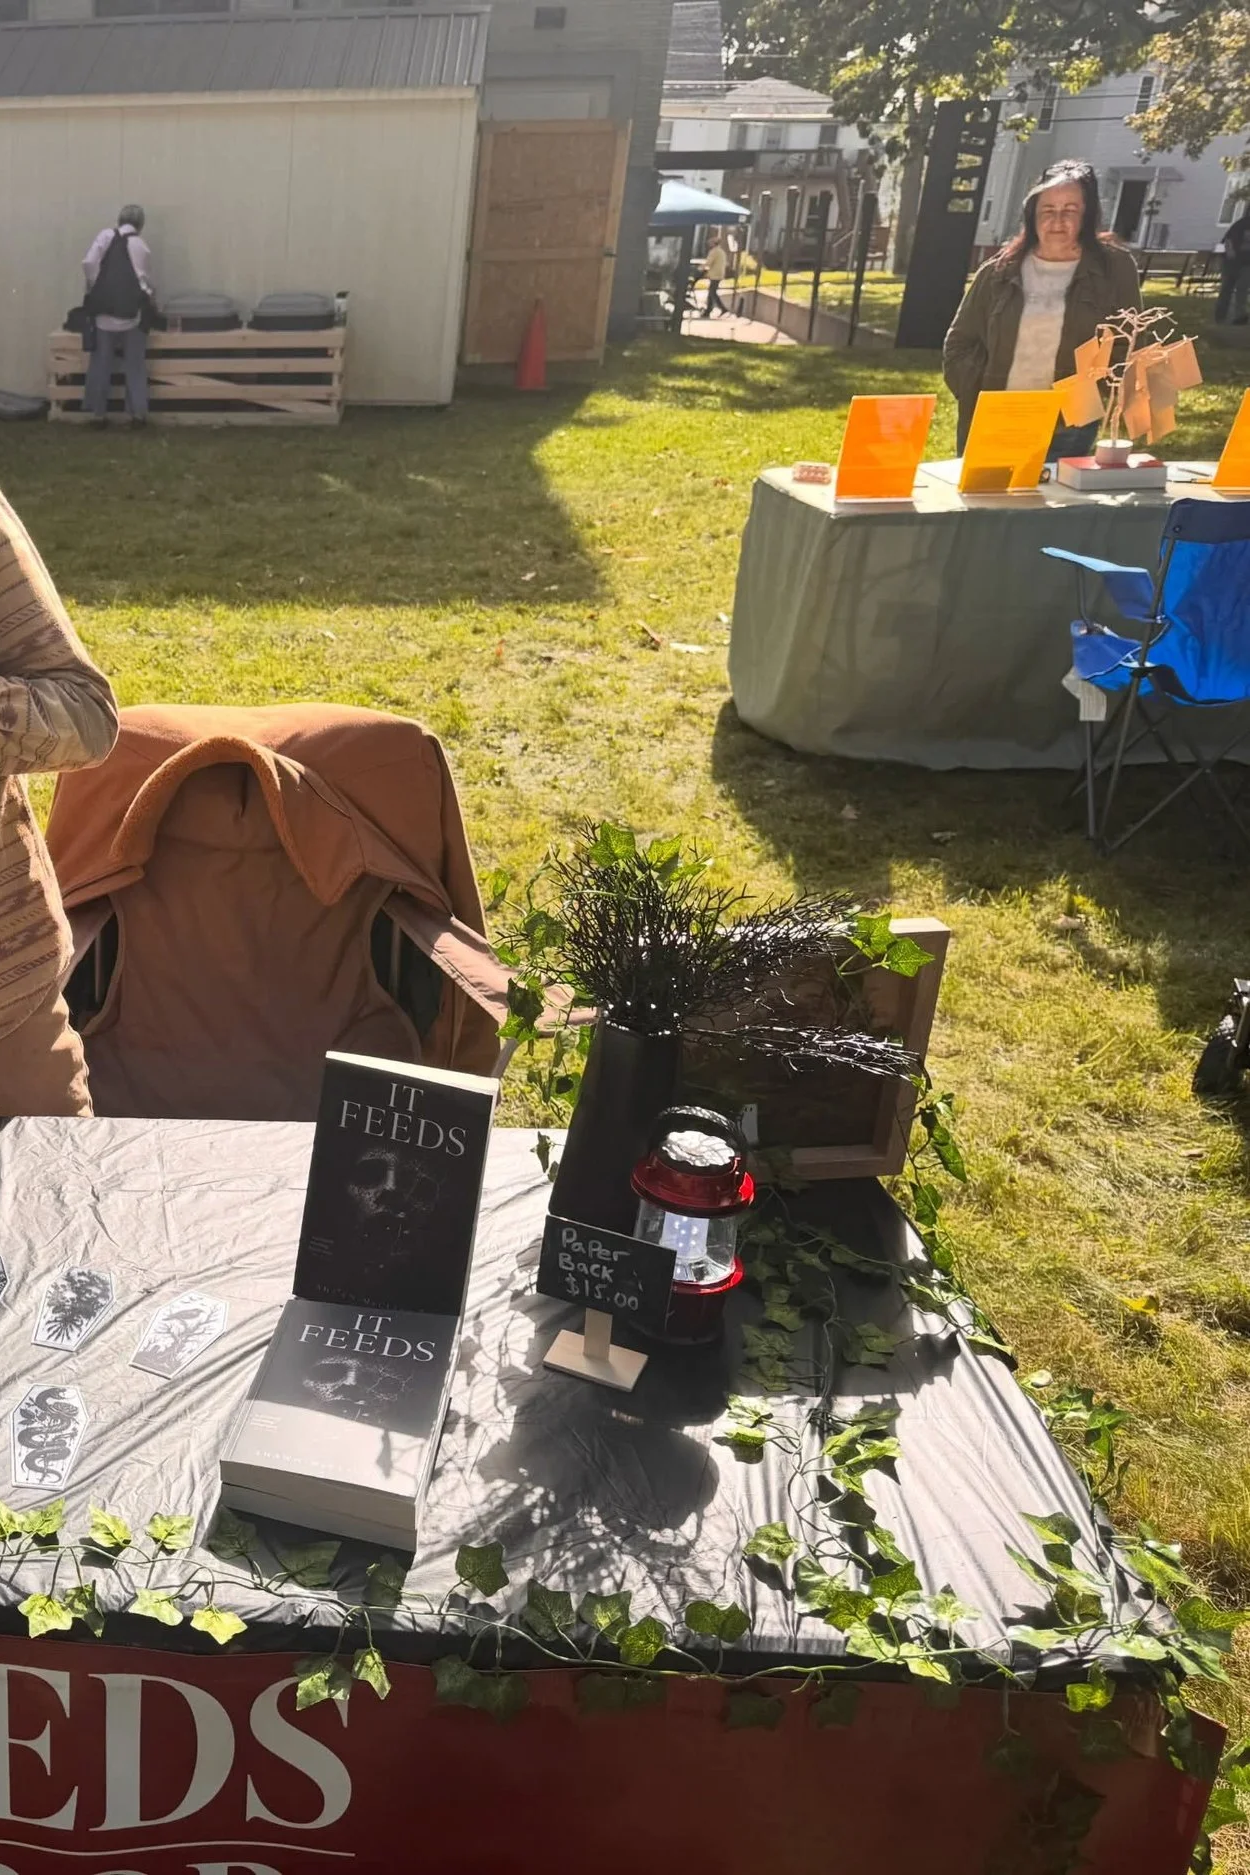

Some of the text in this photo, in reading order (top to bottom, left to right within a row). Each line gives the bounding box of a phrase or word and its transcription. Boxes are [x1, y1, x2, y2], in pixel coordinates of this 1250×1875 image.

[387, 1082, 424, 1113] IT
[338, 1100, 467, 1157] FEEDS
[564, 1272, 639, 1311] $15.00
[352, 1313, 392, 1334] IT
[298, 1324, 436, 1362] FEEDS
